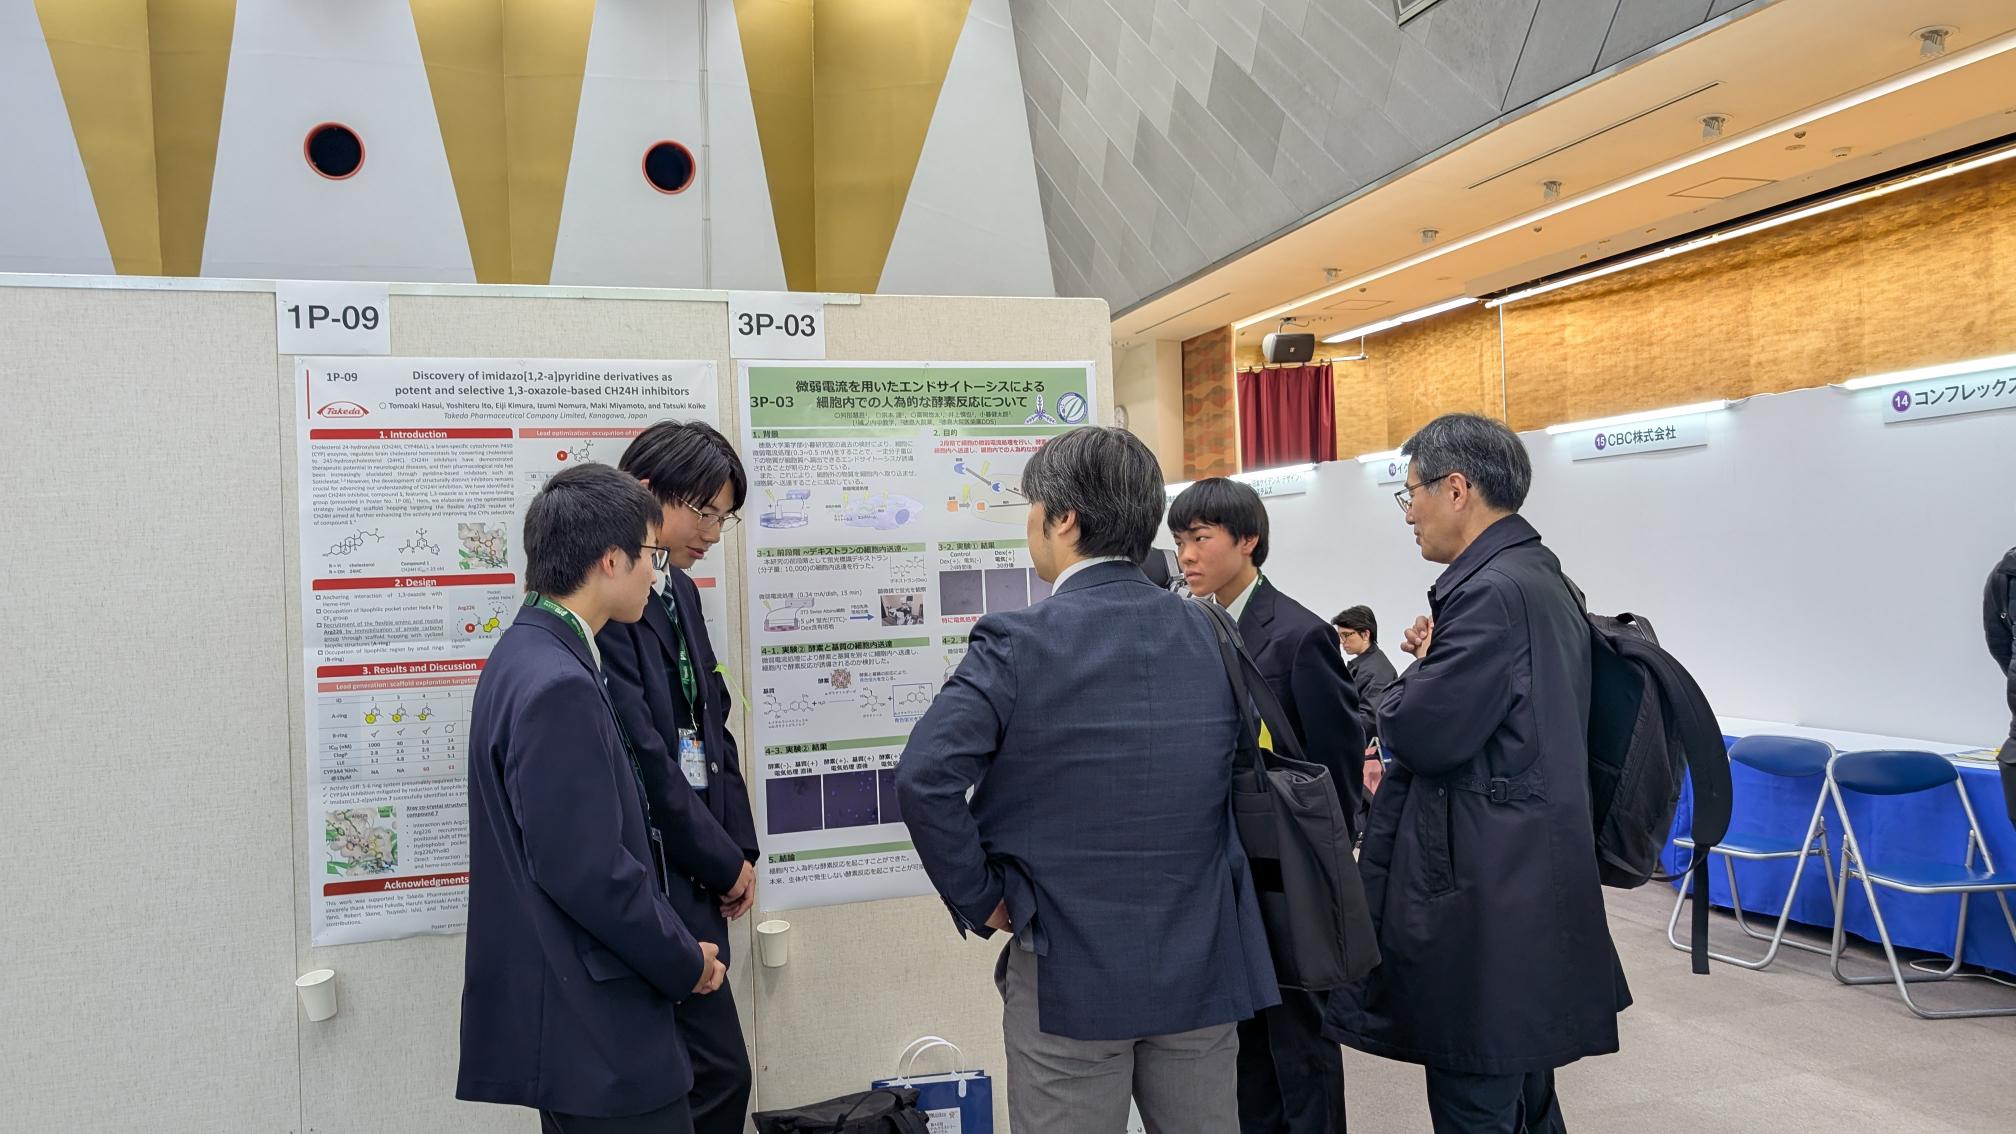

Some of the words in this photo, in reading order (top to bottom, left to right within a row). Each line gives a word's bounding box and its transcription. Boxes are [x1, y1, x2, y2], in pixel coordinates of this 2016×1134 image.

[288, 305, 379, 330] 1P-09
[738, 313, 816, 336] 3P-03
[327, 373, 358, 382] 1P-09
[413, 371, 464, 382] Discovery
[468, 371, 479, 380] of
[482, 371, 600, 382] imidazo[1,2-a]pyridine
[604, 372, 658, 381] derivatives
[395, 386, 431, 396] potent
[435, 386, 454, 394] and
[458, 385, 504, 394] selective
[508, 386, 601, 396] 1,3-oxazole-based
[605, 387, 638, 395] CH24H
[642, 387, 689, 396] inhibitors
[796, 380, 1044, 393] 微弱電流を用いたエンドサイトーシスによる
[422, 402, 444, 410] Hasui,
[496, 402, 506, 410] Eiji
[750, 396, 794, 408] 3P-03
[816, 396, 1028, 408] 細胞内での人為的な酵素反応について
[1895, 395, 1909, 408] 14
[328, 407, 360, 415] Takeda
[391, 430, 447, 439] Introduction
[763, 430, 778, 438] 背景
[1608, 425, 1676, 446] CBC株式会社
[938, 543, 953, 551] 3-2.
[395, 579, 404, 587] 2.
[406, 578, 436, 588] Design
[762, 647, 778, 655] 4-1.
[363, 667, 371, 675] 3.
[374, 666, 406, 674] Results
[410, 665, 426, 673] and
[430, 663, 476, 671] Discussion
[390, 680, 414, 688] scaffold
[416, 679, 450, 687] exploration
[384, 877, 470, 890] Acknowledgments
